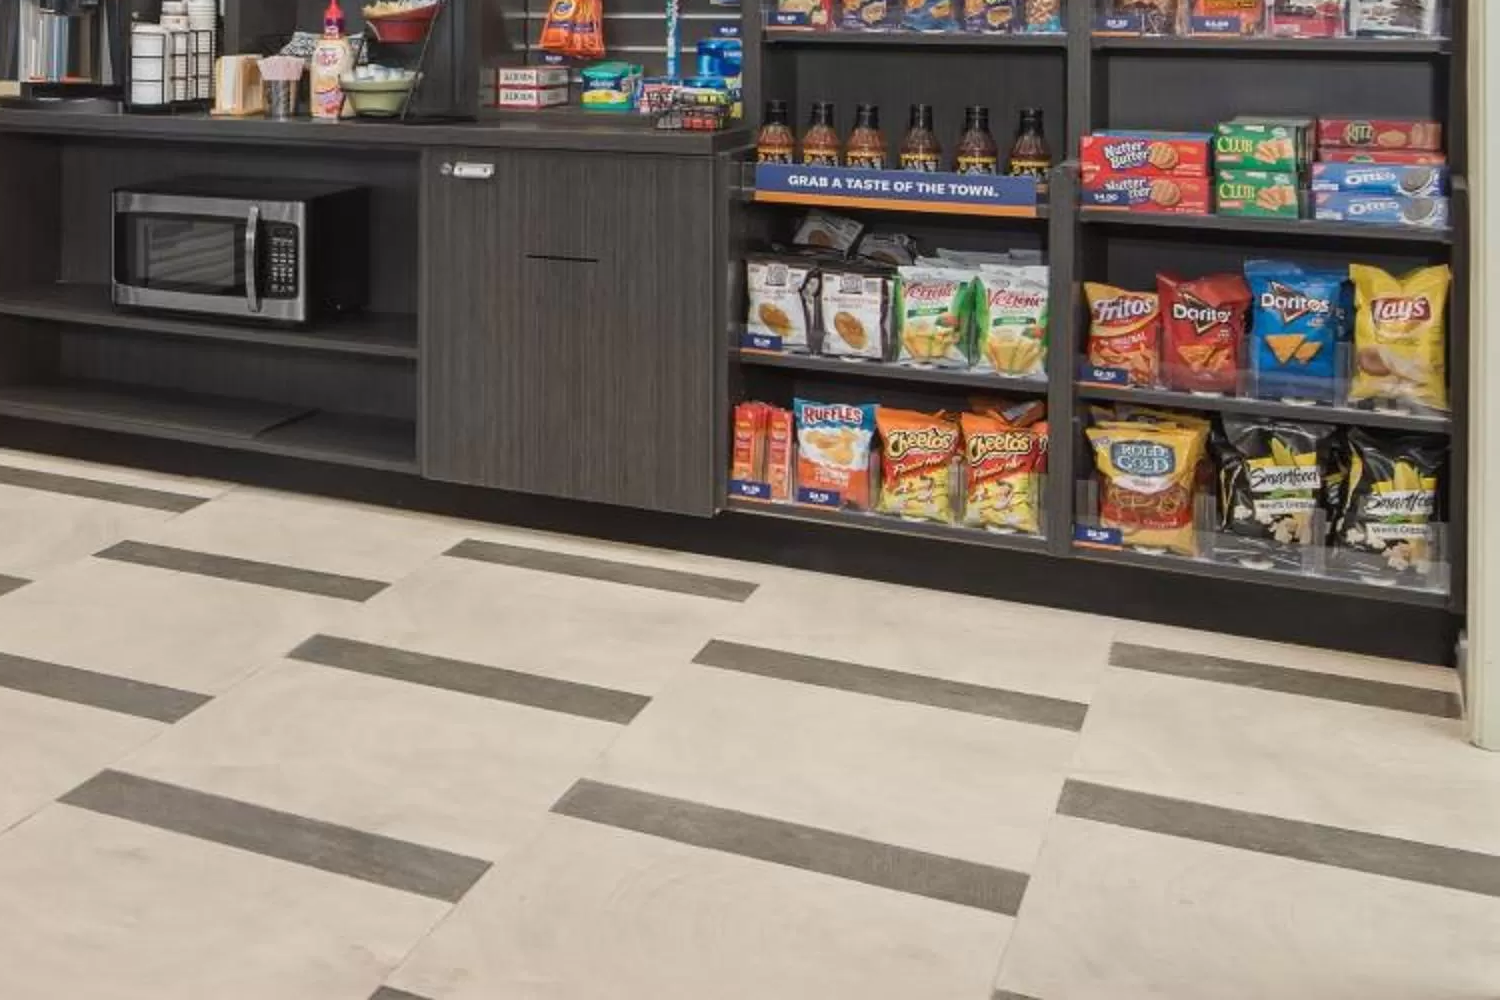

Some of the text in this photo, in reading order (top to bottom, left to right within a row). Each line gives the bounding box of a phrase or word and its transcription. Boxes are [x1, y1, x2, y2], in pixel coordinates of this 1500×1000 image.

[1104, 141, 1146, 159] Nutter
[1110, 149, 1151, 169] Butter
[788, 175, 999, 198] GRAB A TASTE OF THE TOWN.
[1093, 297, 1153, 321] Fritos
[1260, 293, 1331, 313] Doritos
[1373, 299, 1427, 320] Lay's
[803, 403, 863, 425] RUFFLES
[887, 428, 954, 456] Cheetos
[968, 431, 1030, 463] Cheetos
[1119, 443, 1168, 458] ROLD
[1117, 455, 1169, 473] GOLD
